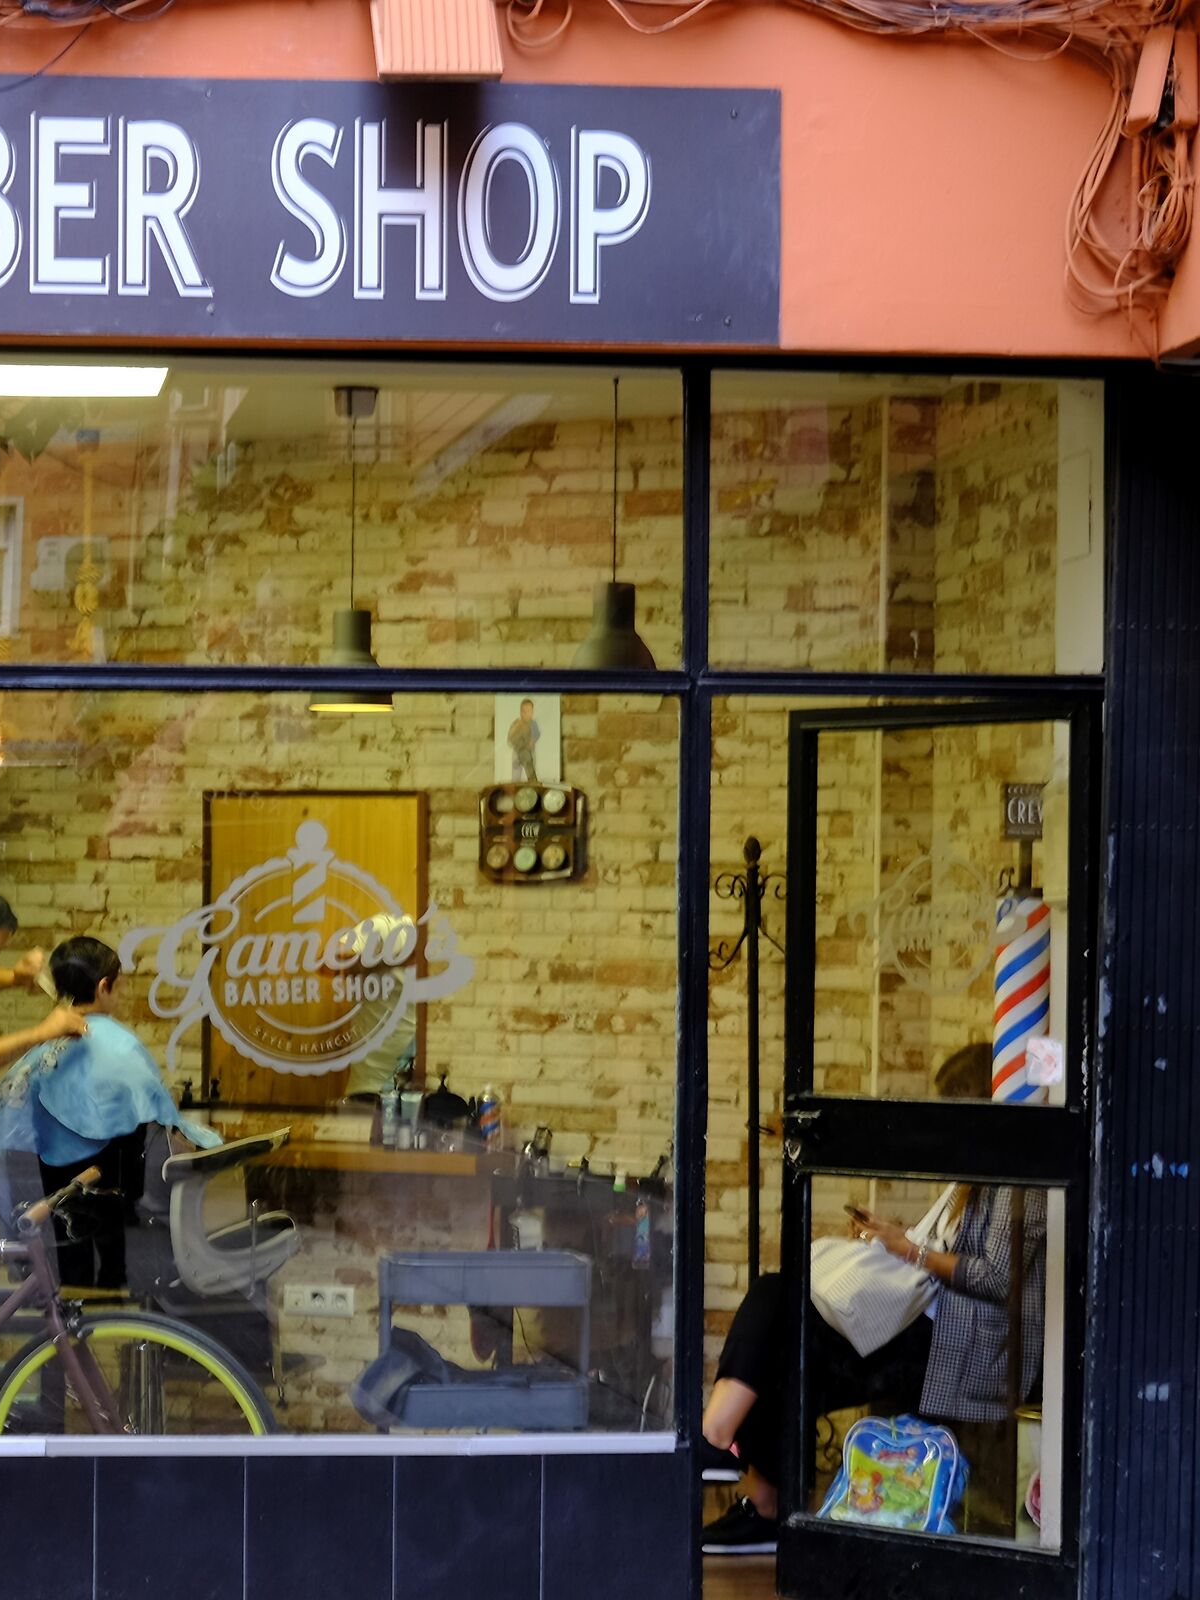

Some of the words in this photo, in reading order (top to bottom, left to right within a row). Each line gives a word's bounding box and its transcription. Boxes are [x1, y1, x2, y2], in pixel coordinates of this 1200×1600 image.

[269, 115, 652, 305] SHOP
[223, 979, 321, 1007] BARBER
[332, 974, 396, 1002] SHOP
[252, 1027, 293, 1052] STYLE
